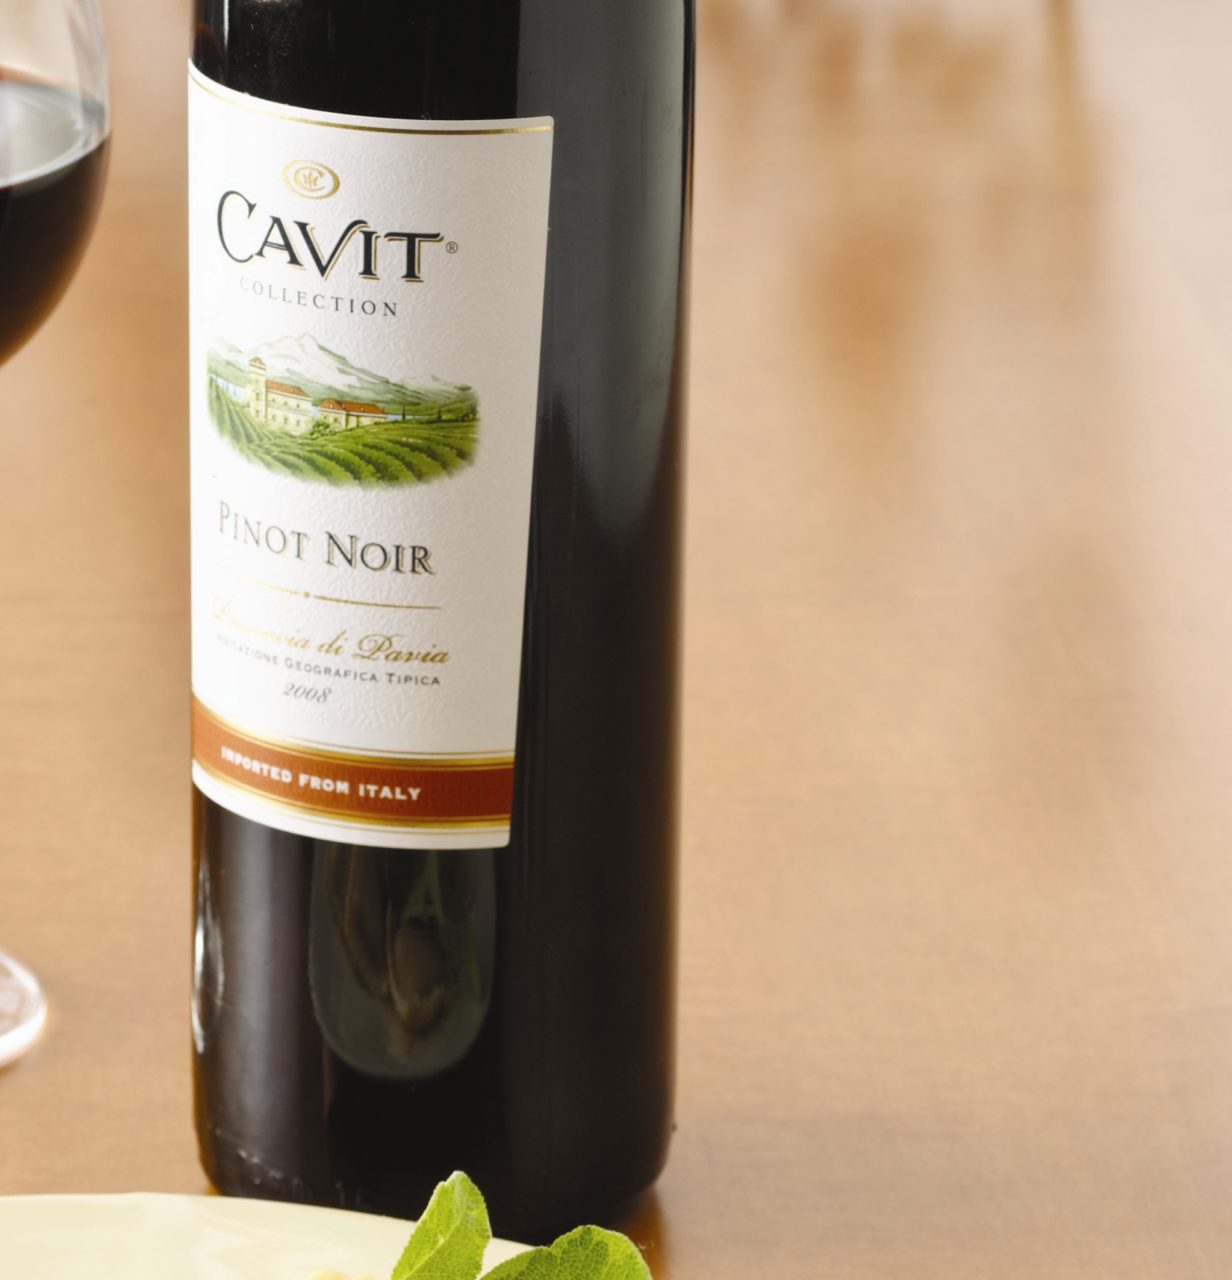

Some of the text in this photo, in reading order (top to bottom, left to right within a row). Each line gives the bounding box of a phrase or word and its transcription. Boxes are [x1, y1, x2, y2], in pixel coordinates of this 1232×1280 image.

[239, 276, 398, 317] COLLECTION
[219, 500, 436, 576] PINOT NOIR
[317, 629, 450, 664] di Pavia
[284, 656, 378, 683] GEOGRAFICA
[385, 672, 441, 686] TIPICA
[281, 682, 333, 704] 2008
[221, 746, 422, 801] IMPORTED FROM ITALY
